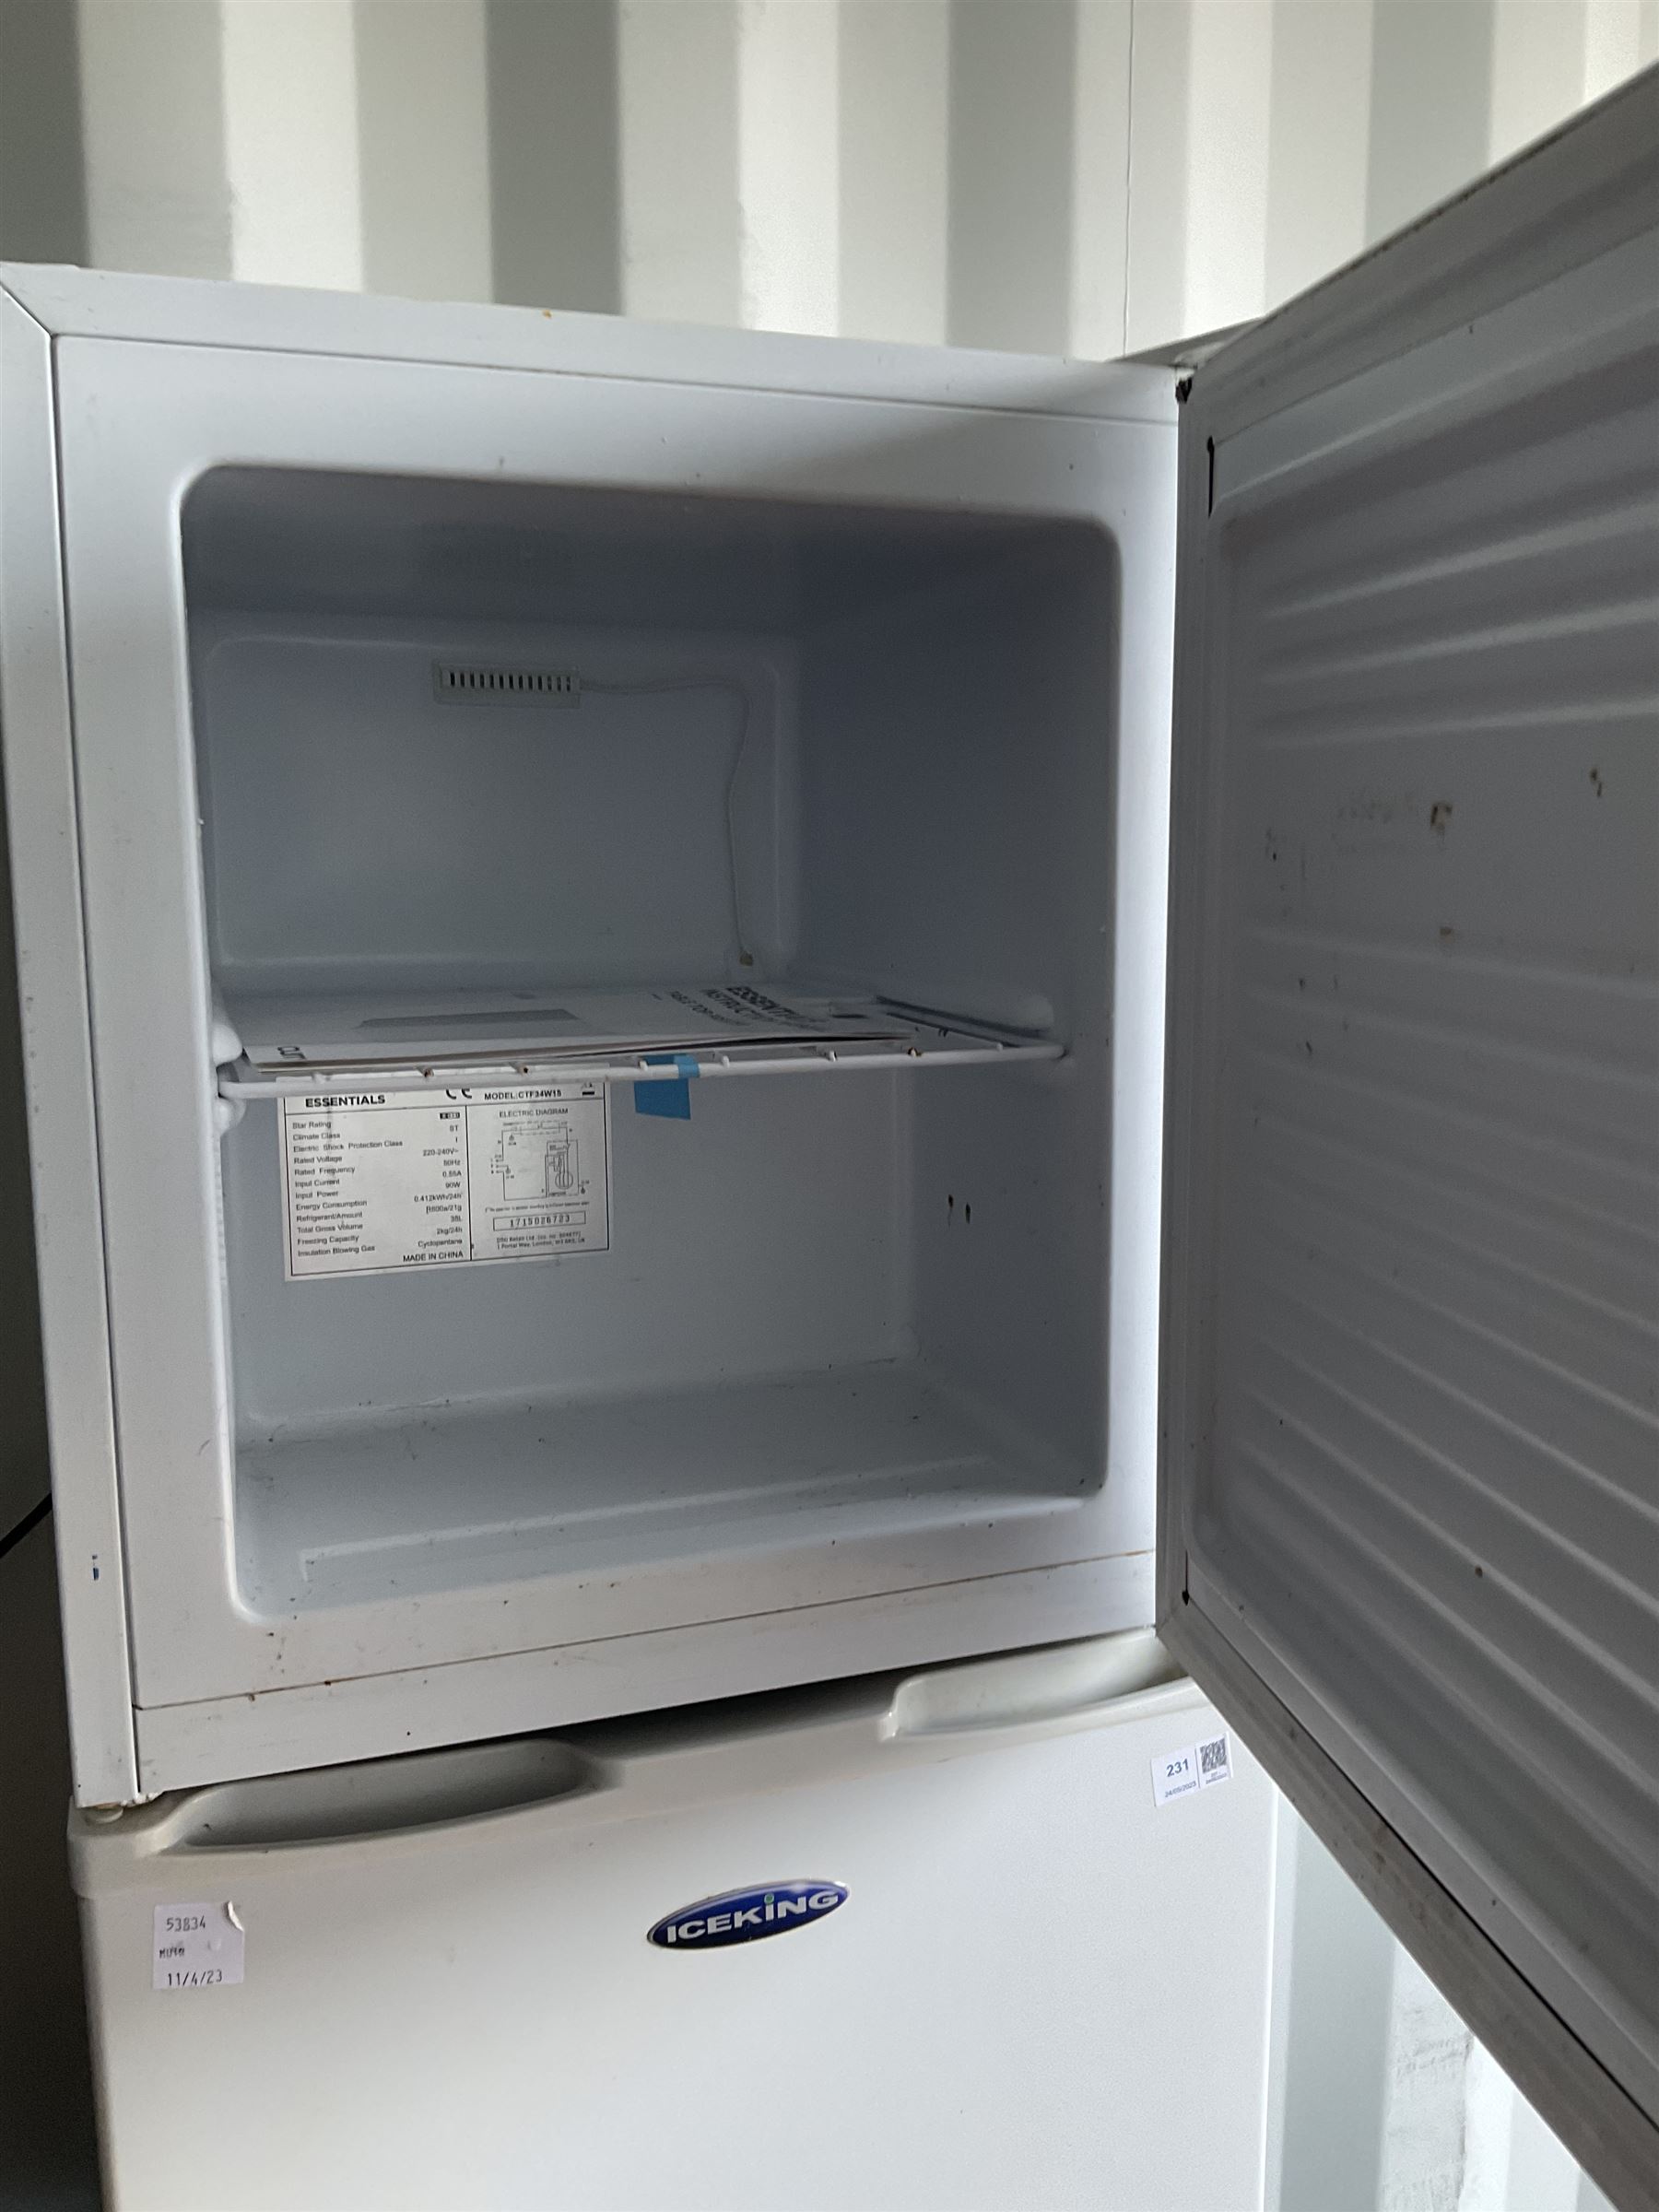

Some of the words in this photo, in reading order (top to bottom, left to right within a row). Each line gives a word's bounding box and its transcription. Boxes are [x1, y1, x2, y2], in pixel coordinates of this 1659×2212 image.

[306, 1094, 385, 1108] ESSENTIALS
[499, 1110, 534, 1118] ELECTRIC
[535, 1108, 569, 1117] DIAGRAM
[292, 1122, 307, 1130] Star
[309, 1120, 332, 1130] Rating
[293, 1133, 320, 1141] Climate
[321, 1132, 341, 1140] Class
[293, 1145, 320, 1153] Electric
[348, 1141, 382, 1150] Protection
[294, 1156, 315, 1164] Rated
[316, 1155, 343, 1164] Voltage
[294, 1168, 315, 1176] Rated
[319, 1166, 356, 1176] Frequency
[295, 1180, 312, 1188] Input
[314, 1178, 340, 1187] Current
[297, 1203, 321, 1211] Energy
[323, 1200, 368, 1209] Consumption
[297, 1211, 363, 1223] Refrigerant/Amount
[315, 1225, 336, 1233] Gross
[337, 1222, 363, 1231] Volume
[298, 1237, 328, 1245] Freezing
[329, 1235, 359, 1244] Capacity
[299, 1249, 331, 1257] Insulation
[333, 1246, 359, 1255] Blowing
[403, 1253, 426, 1262] MADE
[439, 1251, 464, 1259] CHINA
[1166, 1758, 1189, 1778] 231
[166, 1915, 206, 1932] 53834
[168, 1970, 222, 1985] 11/4/23
